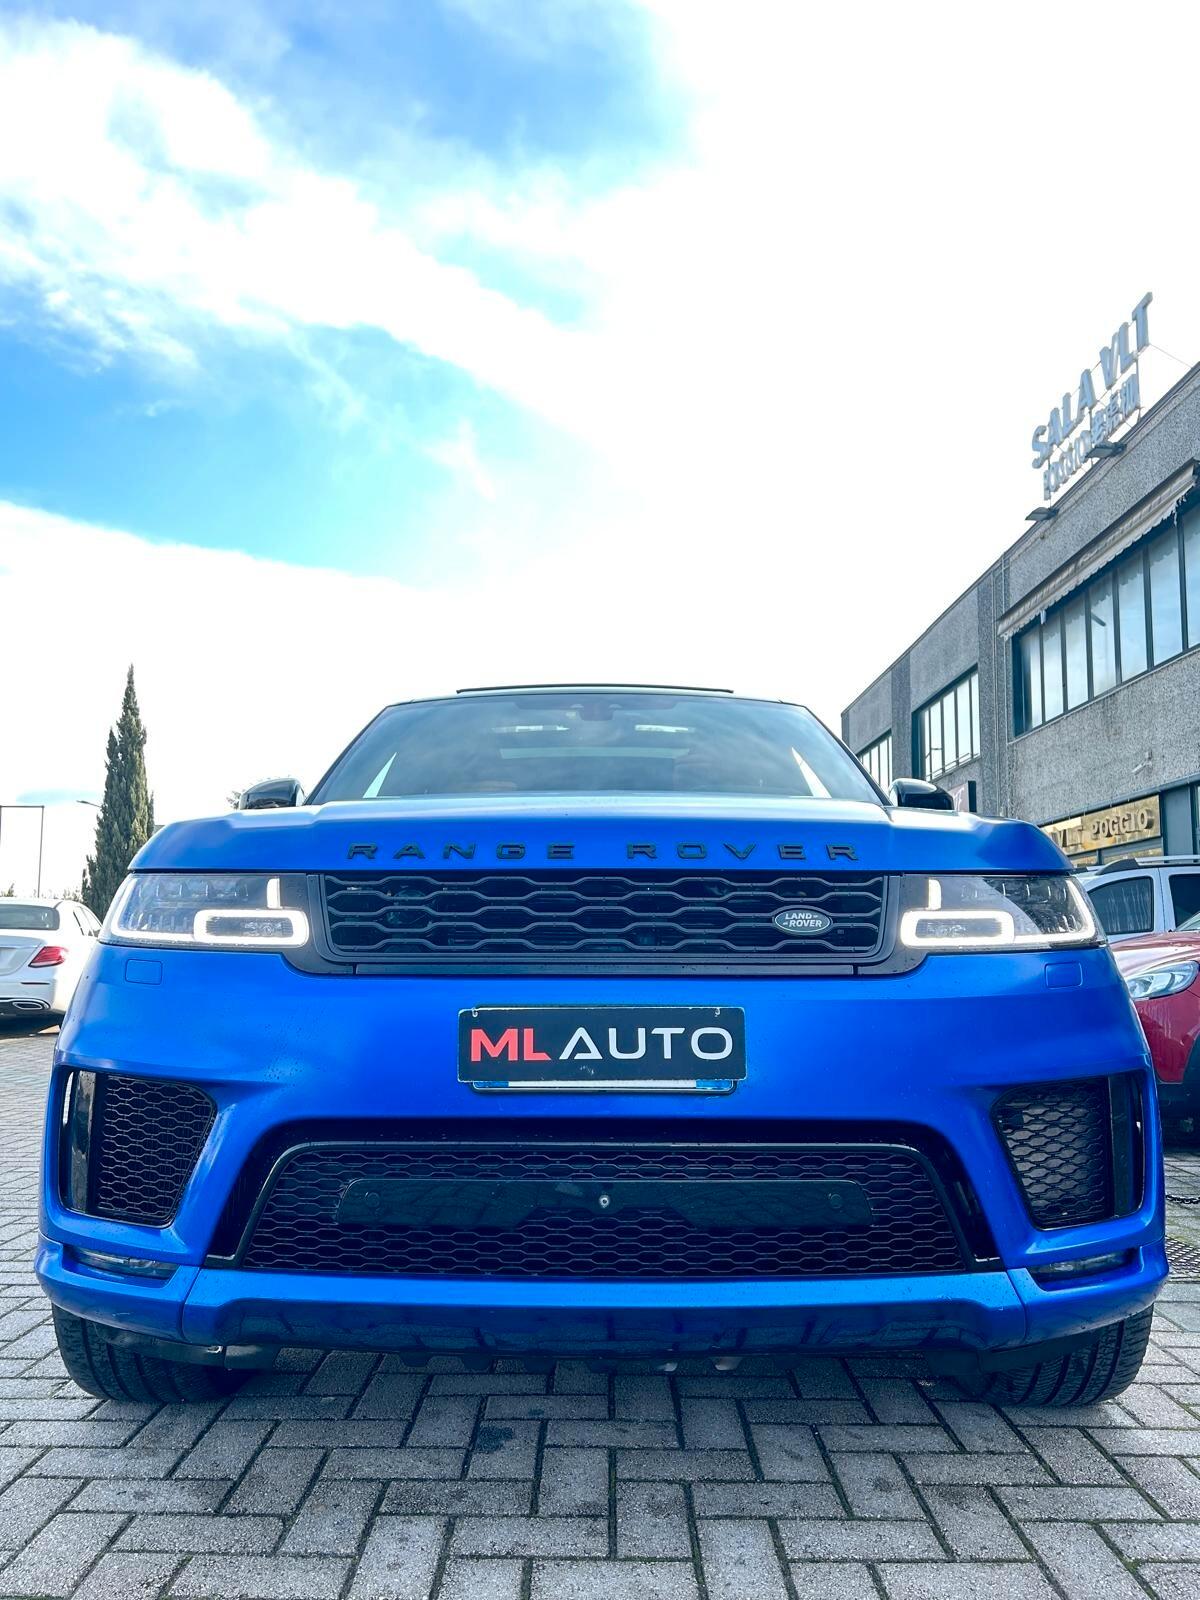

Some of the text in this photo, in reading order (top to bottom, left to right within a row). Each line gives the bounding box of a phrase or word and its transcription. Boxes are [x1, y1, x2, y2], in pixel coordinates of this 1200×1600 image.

[1032, 368, 1098, 469] SALA
[1099, 291, 1153, 390] VLT
[1092, 808, 1149, 840] POGGIO
[347, 842, 858, 860] RANGE ROVER
[785, 912, 812, 920] LAND
[789, 919, 823, 928] ROVER
[470, 1026, 733, 1062] ML AUTO
